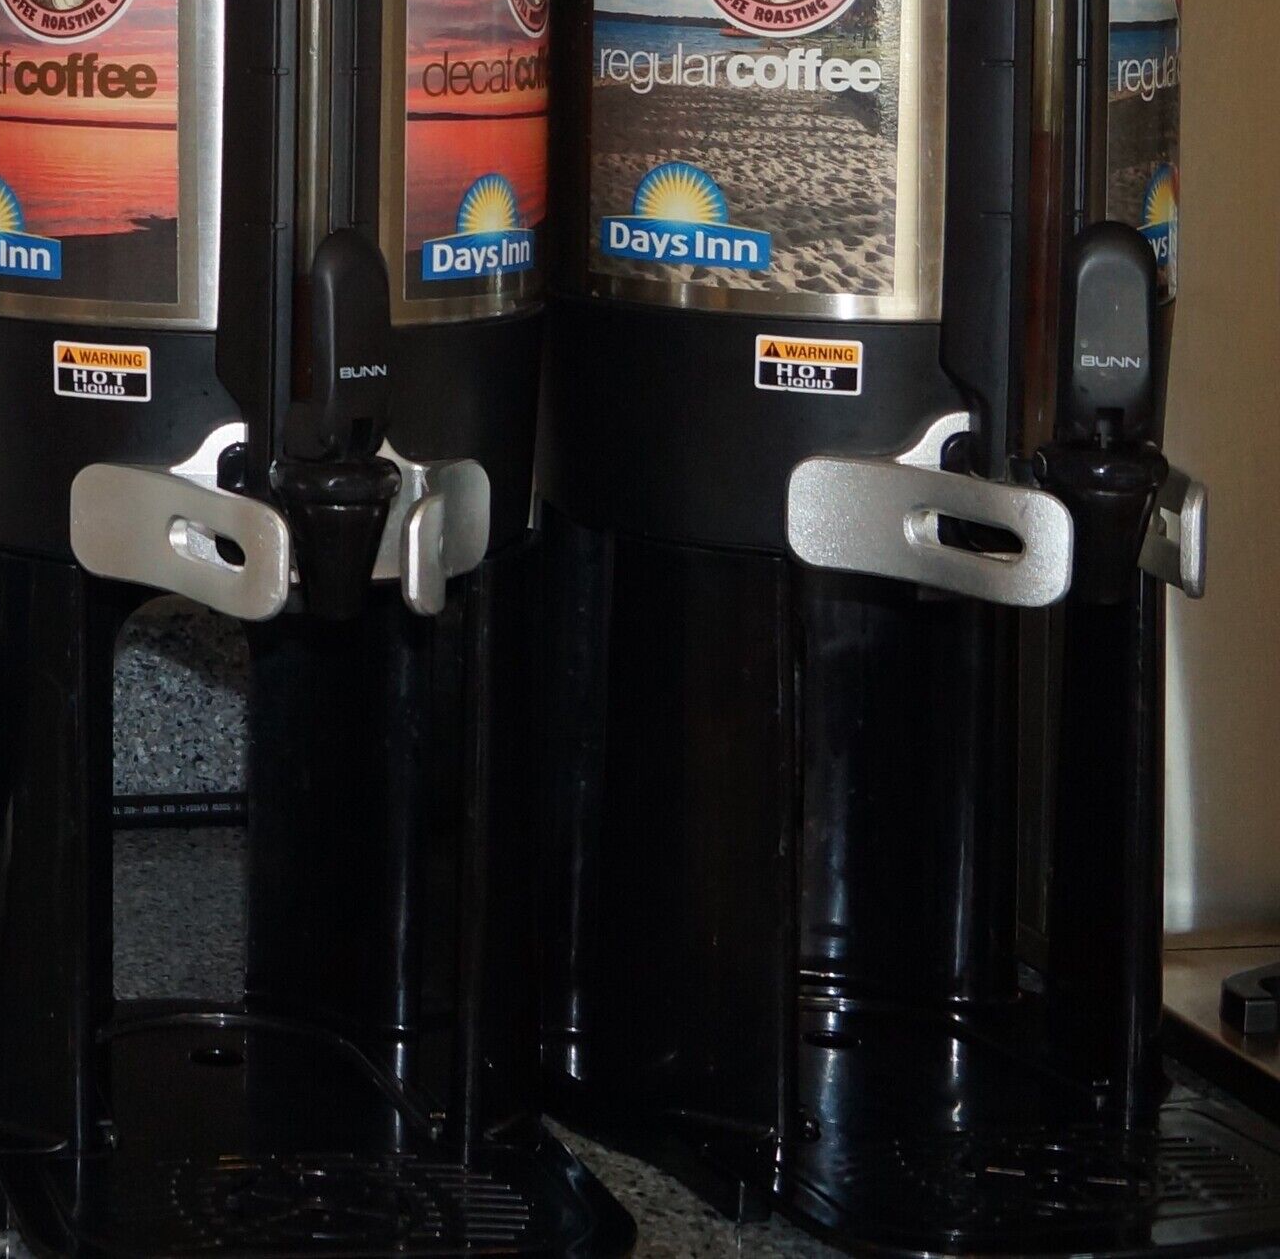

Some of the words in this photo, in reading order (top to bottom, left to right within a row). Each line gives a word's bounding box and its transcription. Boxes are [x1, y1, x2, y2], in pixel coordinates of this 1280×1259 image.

[40, 2, 106, 31] ROASTING
[13, 51, 158, 100] coffee
[422, 49, 512, 98] decaf
[600, 42, 726, 95] regular
[726, 47, 882, 93] coffee
[609, 221, 689, 258] Days
[695, 231, 759, 263] Inn
[0, 239, 51, 272] Inn
[432, 243, 499, 274] Days
[501, 238, 530, 266] Inn
[79, 349, 143, 368] WARNING
[784, 344, 855, 362] WARNING
[1080, 354, 1141, 369] BUNN
[72, 368, 128, 386] HOT
[340, 364, 388, 379] BUNN
[775, 362, 837, 380] HOT
[73, 382, 126, 396] LIQUID
[777, 376, 835, 390] LIQUID
